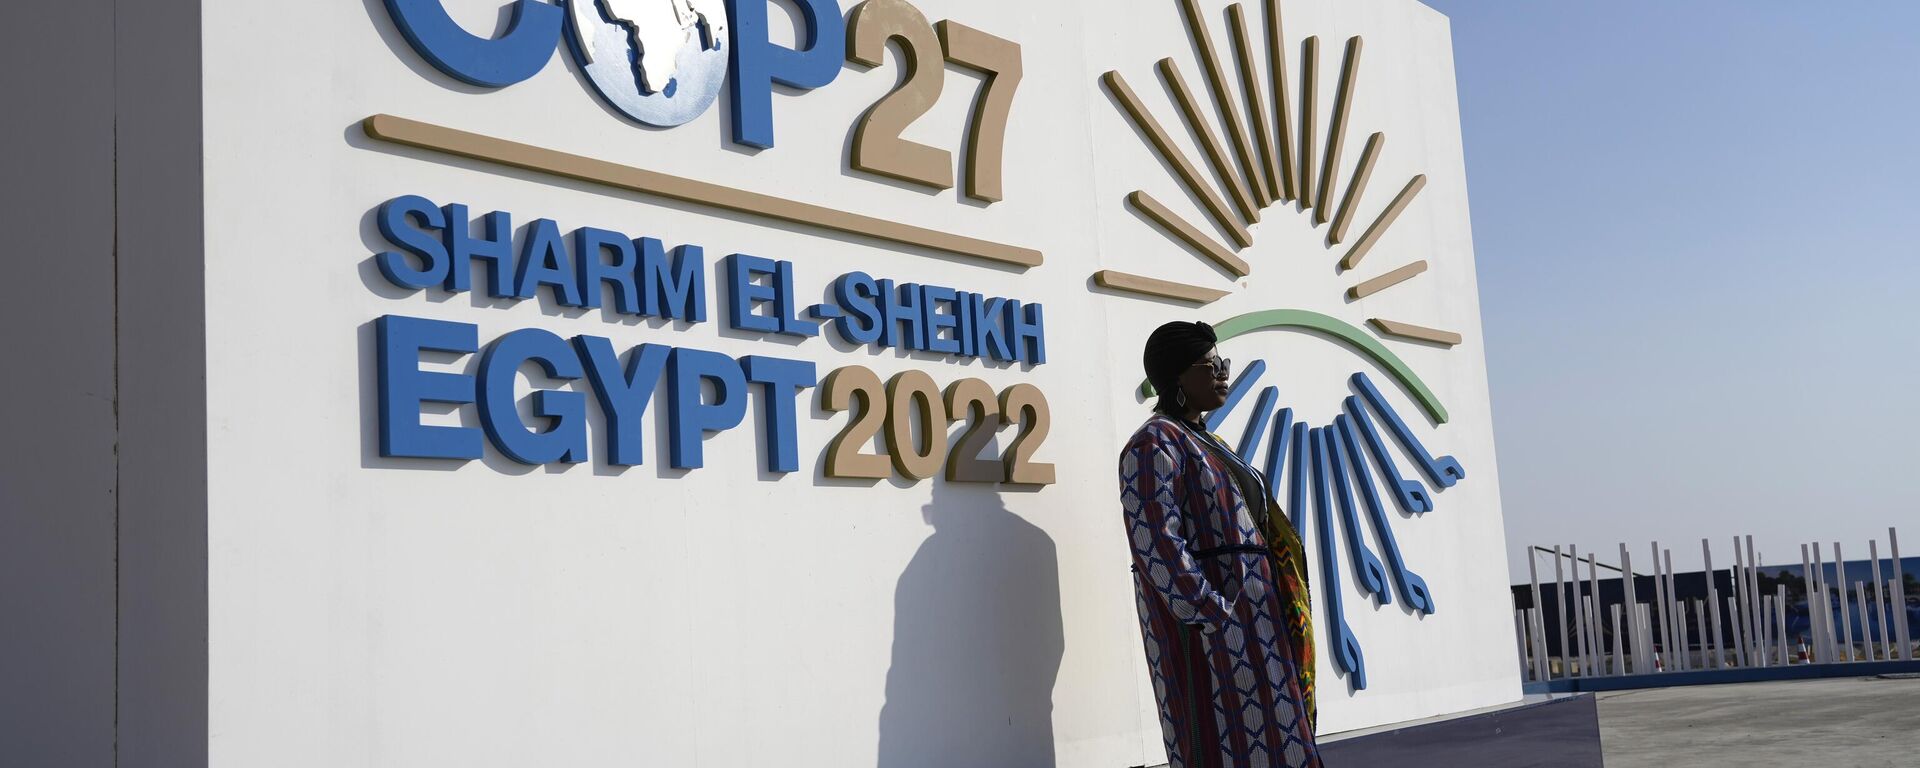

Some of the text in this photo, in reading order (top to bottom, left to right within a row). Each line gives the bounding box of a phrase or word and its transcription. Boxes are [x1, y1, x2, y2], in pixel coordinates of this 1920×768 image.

[376, 195, 1047, 365] SHARM EL-SHEIKH
[377, 314, 1057, 485] EGYPT 2022
